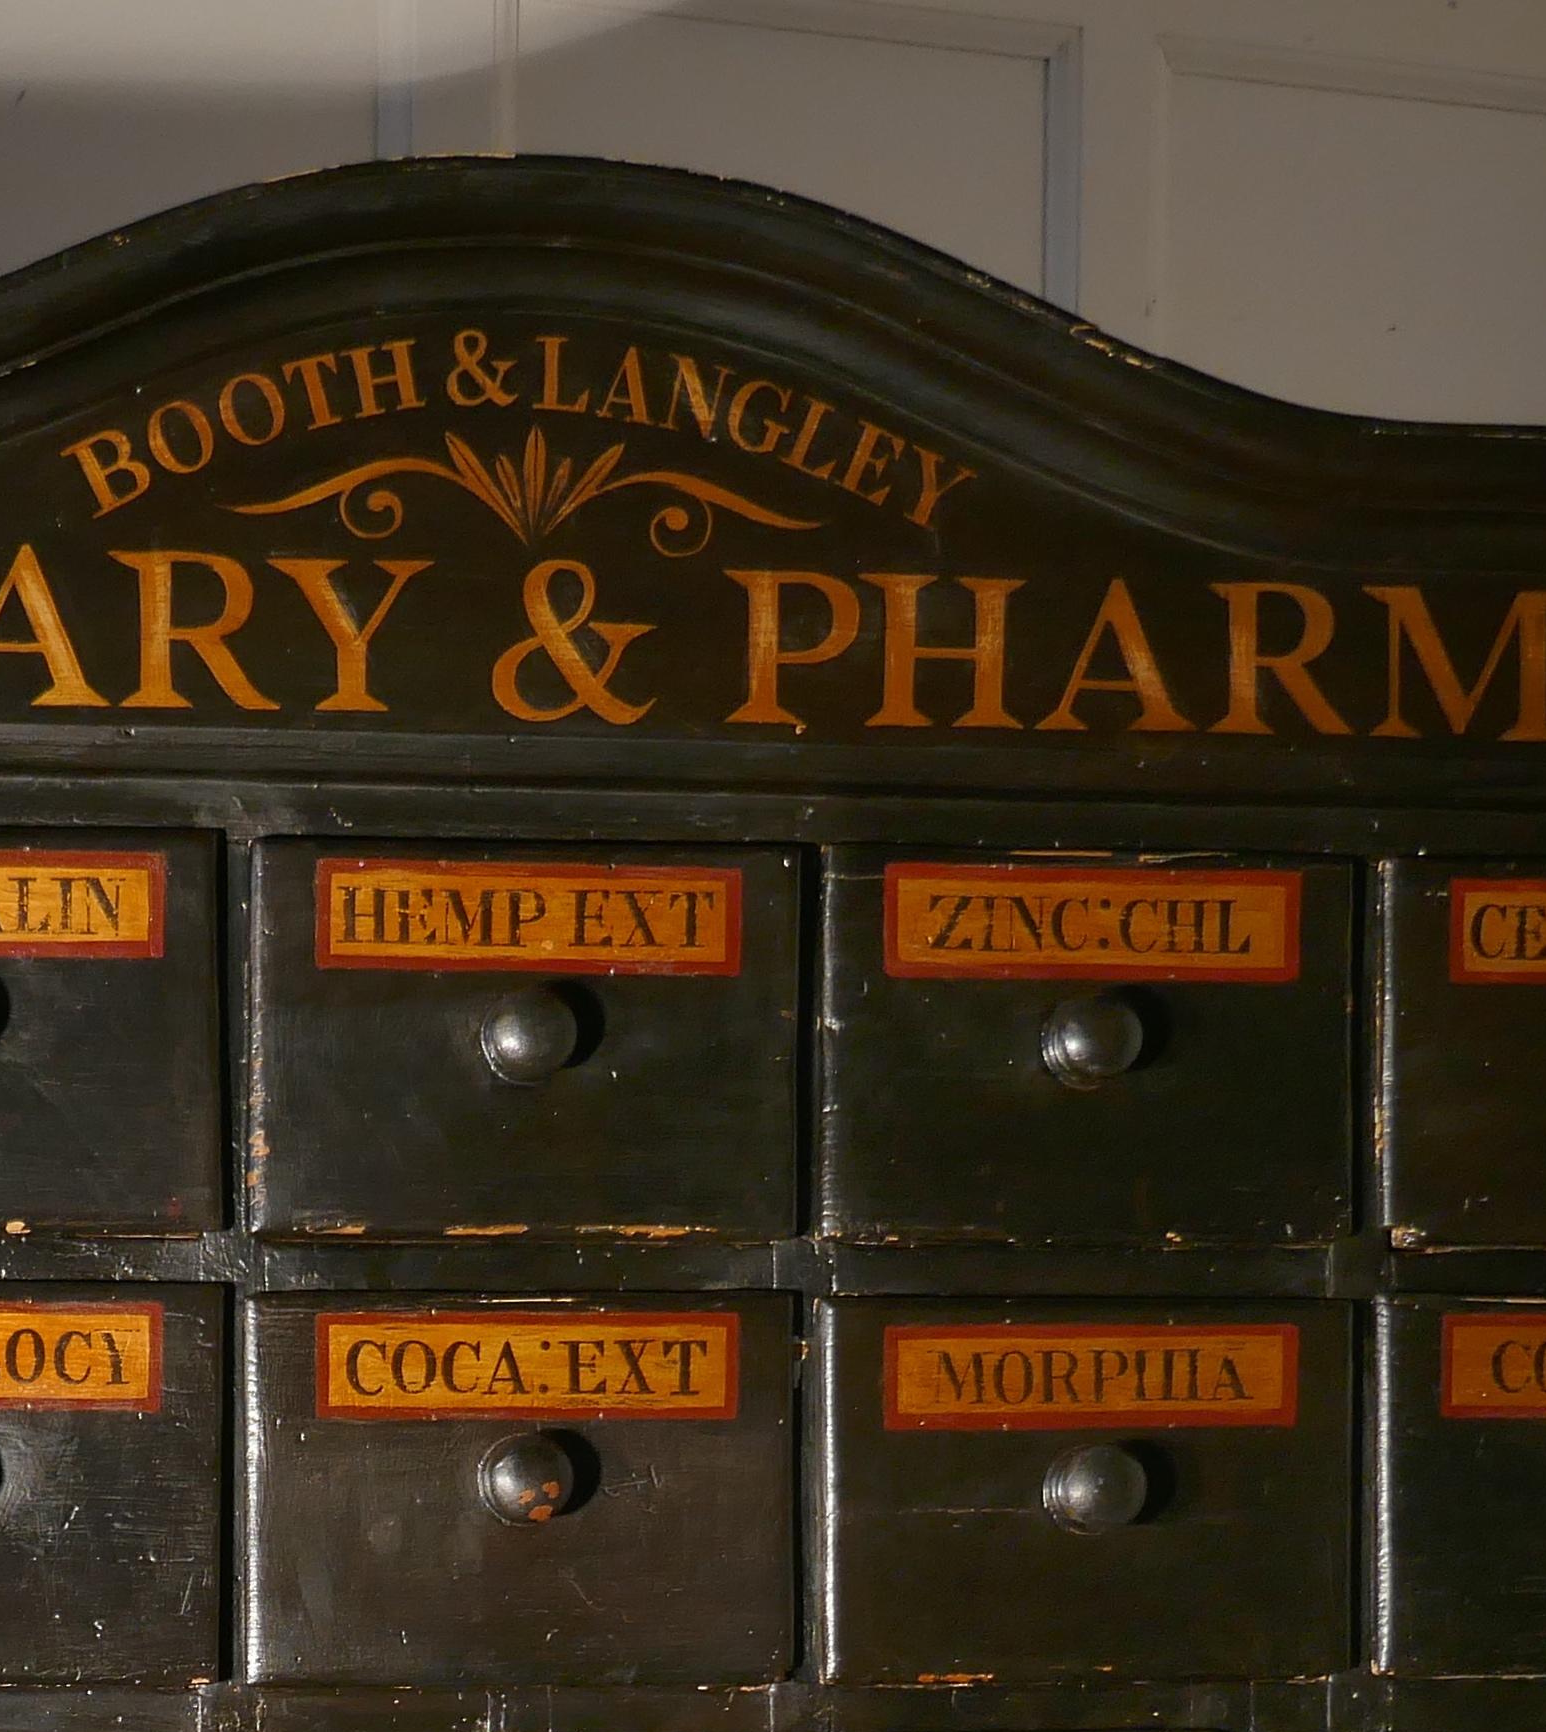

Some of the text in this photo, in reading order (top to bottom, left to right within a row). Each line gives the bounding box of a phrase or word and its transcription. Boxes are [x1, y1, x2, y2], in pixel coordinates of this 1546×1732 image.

[59, 328, 978, 532] BOOTH & LANGLEY
[490, 557, 659, 727] &
[335, 885, 715, 949] HEMP EXT
